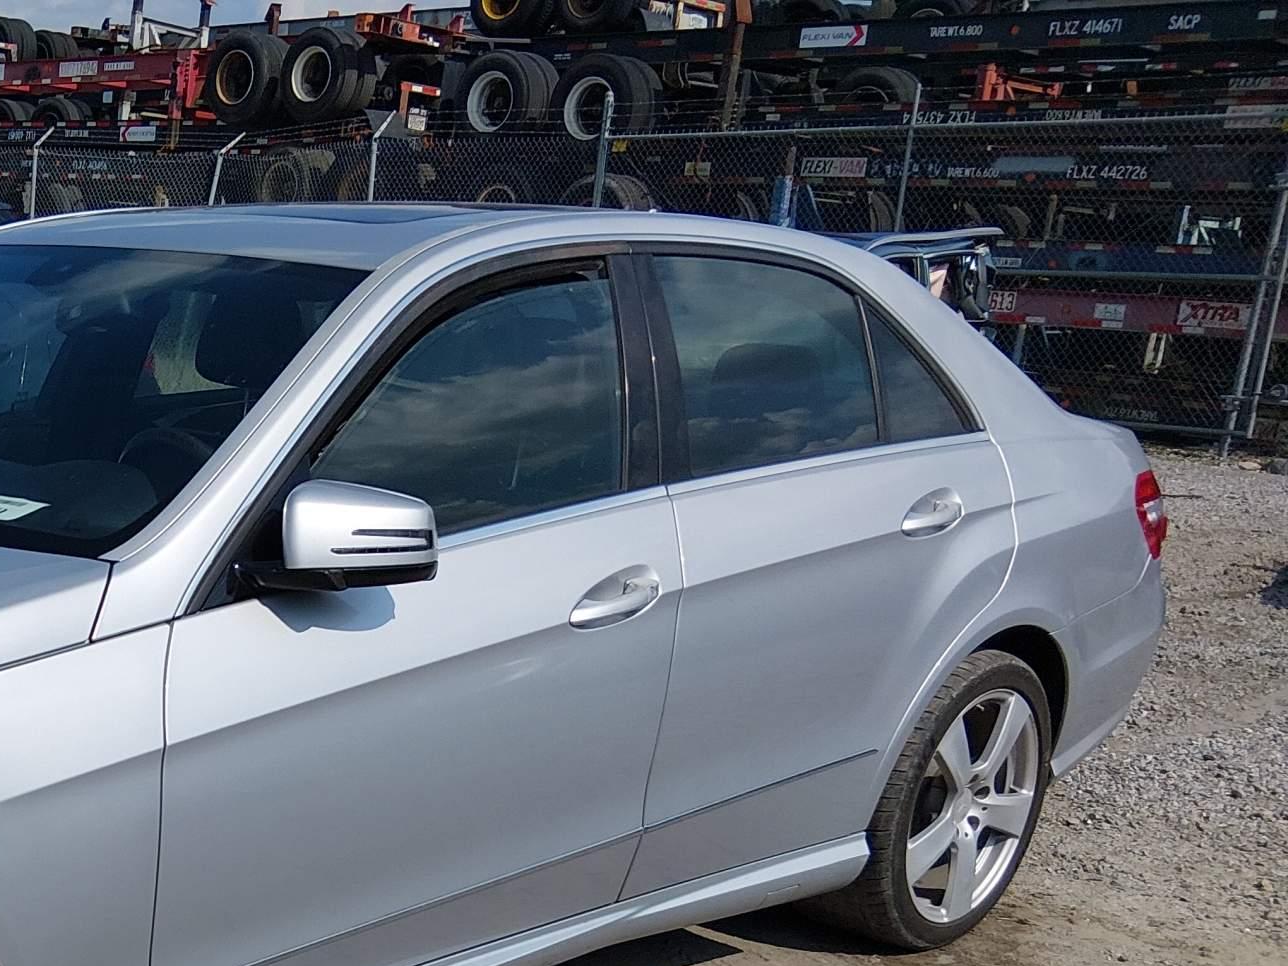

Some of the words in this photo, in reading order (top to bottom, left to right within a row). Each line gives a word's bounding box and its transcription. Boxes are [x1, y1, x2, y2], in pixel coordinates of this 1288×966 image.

[1049, 21, 1078, 36] FLXZ
[1083, 18, 1123, 35] 414671
[1168, 14, 1201, 31] SACP
[902, 111, 944, 125] 43754
[1066, 165, 1096, 179] FLXZ
[1099, 164, 1148, 180] 442726
